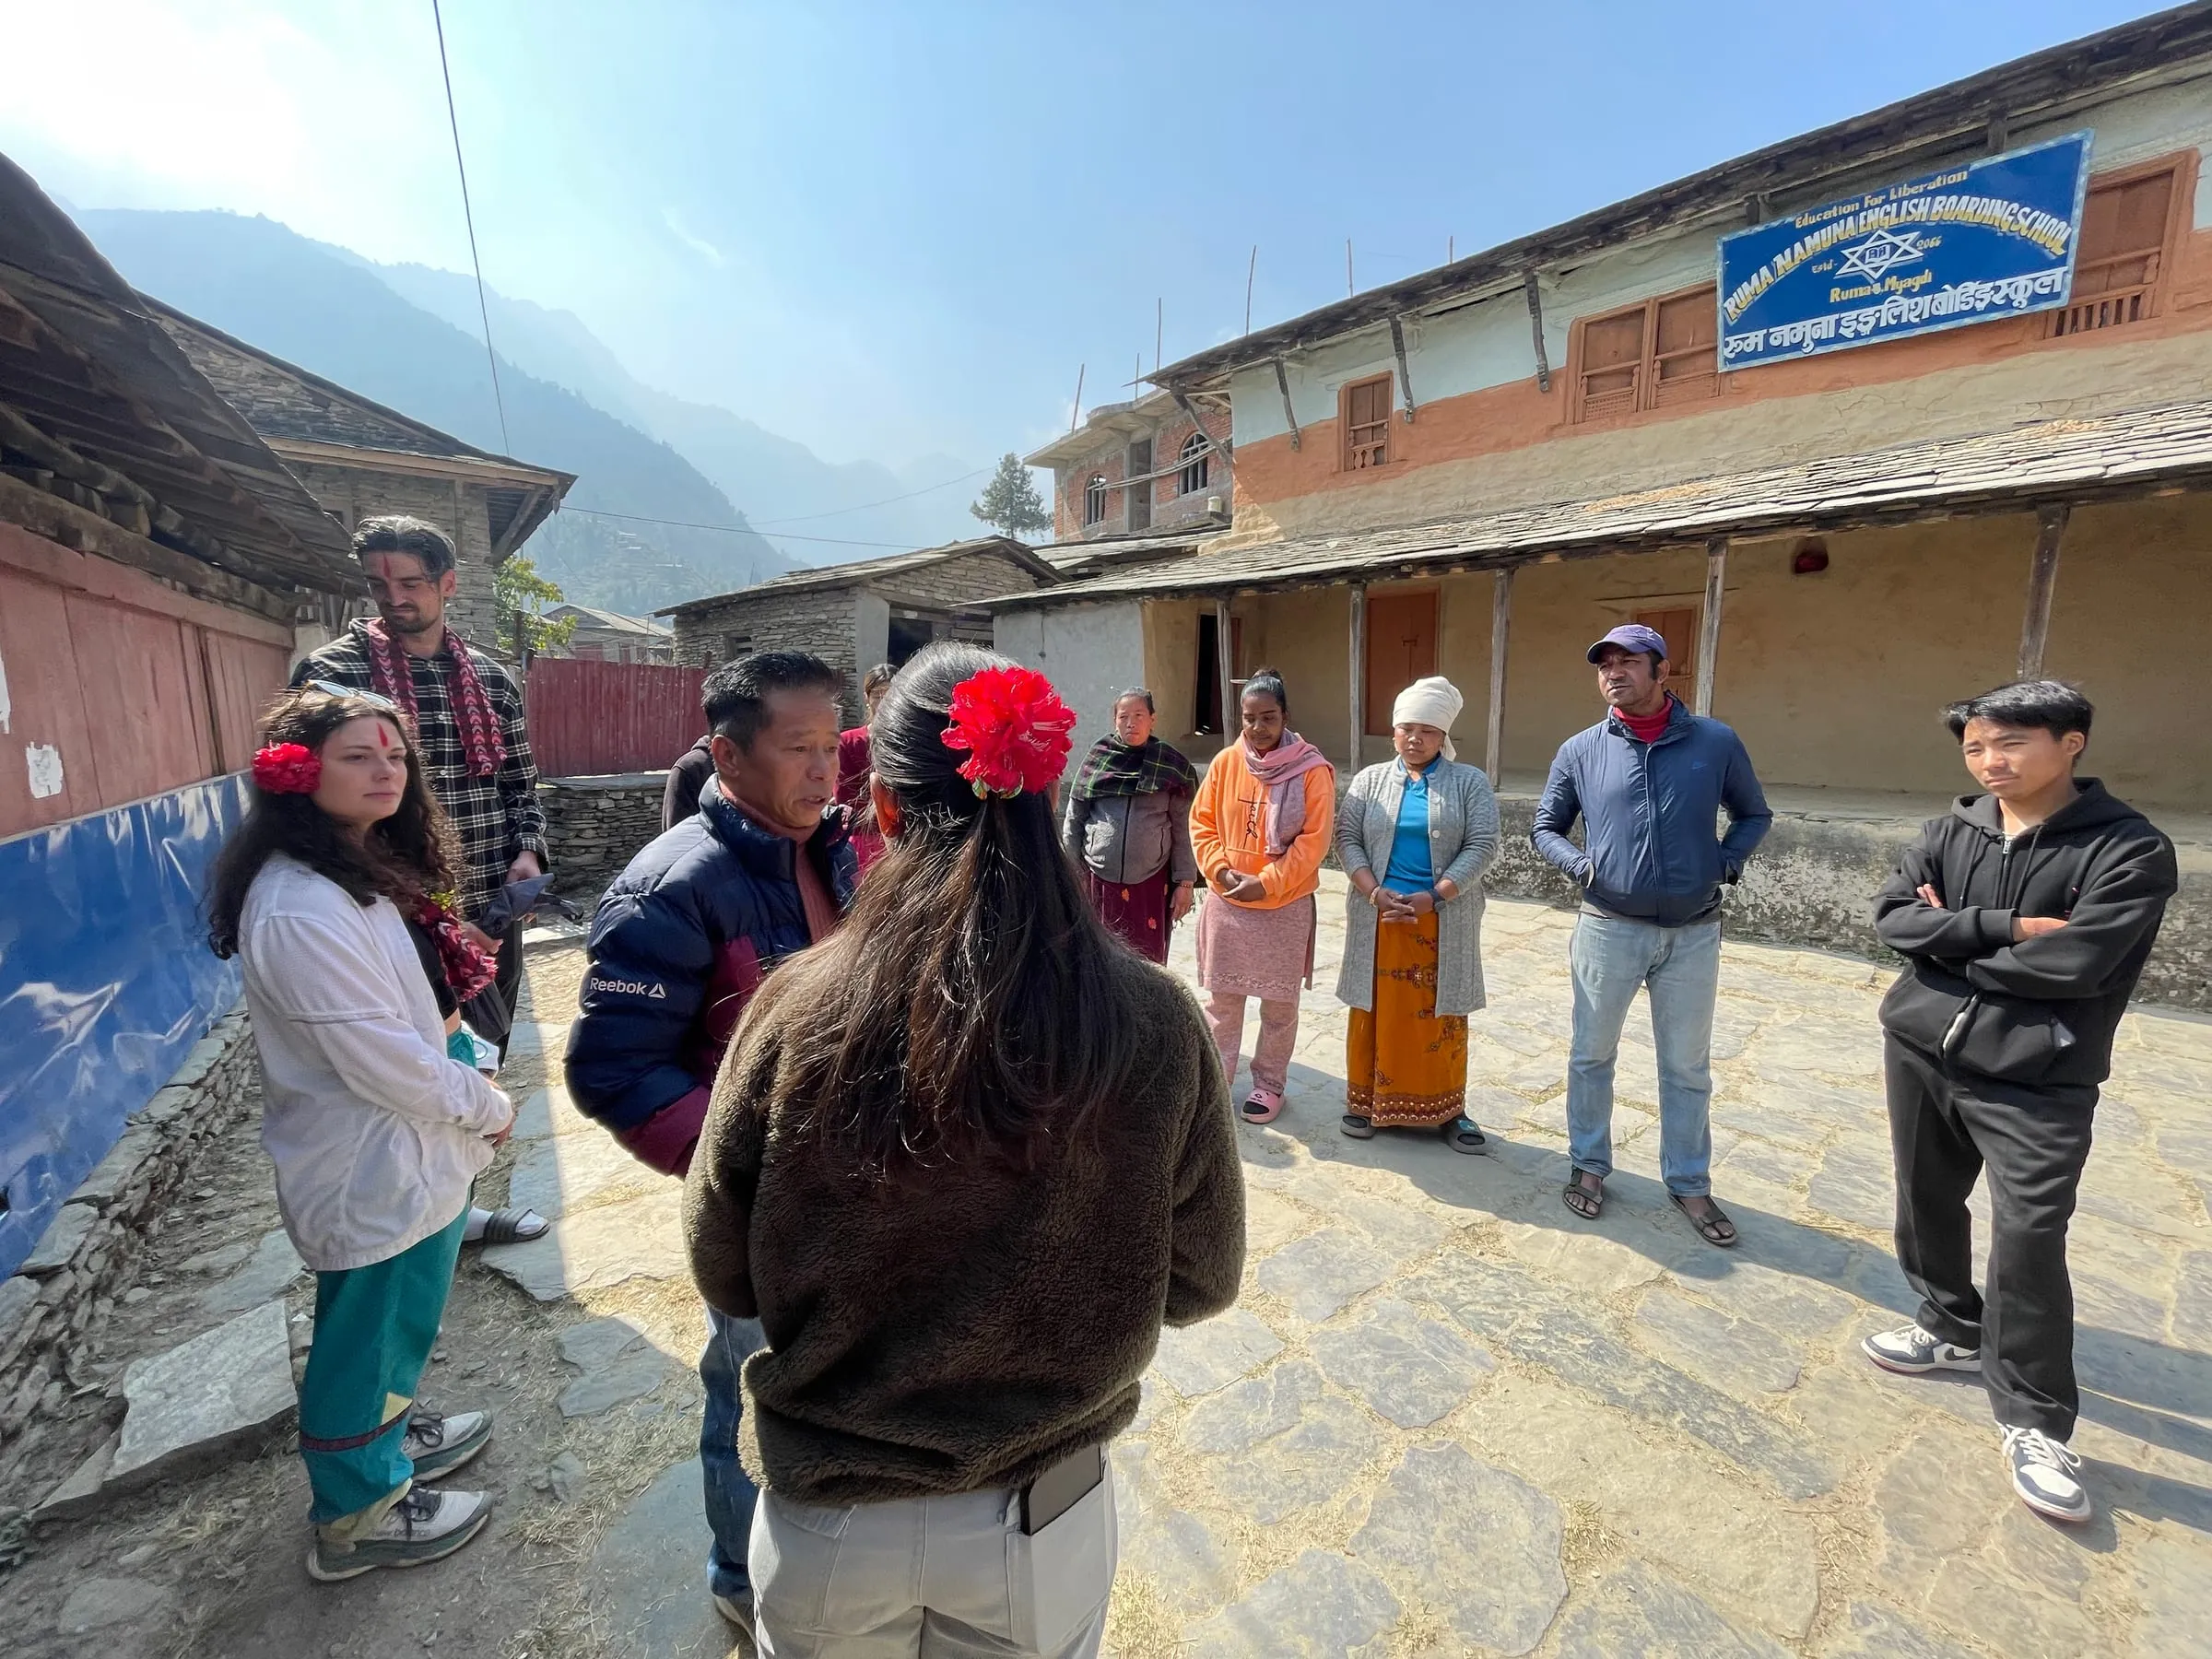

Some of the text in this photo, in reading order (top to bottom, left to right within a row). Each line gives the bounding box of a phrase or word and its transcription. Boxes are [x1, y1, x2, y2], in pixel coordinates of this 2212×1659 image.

[1795, 170, 1970, 229] Education For Liberation
[1724, 194, 2073, 322] RUMA NAMUNA ENGLISH BOARDING SCHOOL
[1769, 312, 1840, 354] नमुना
[589, 977, 647, 995] Reebok
